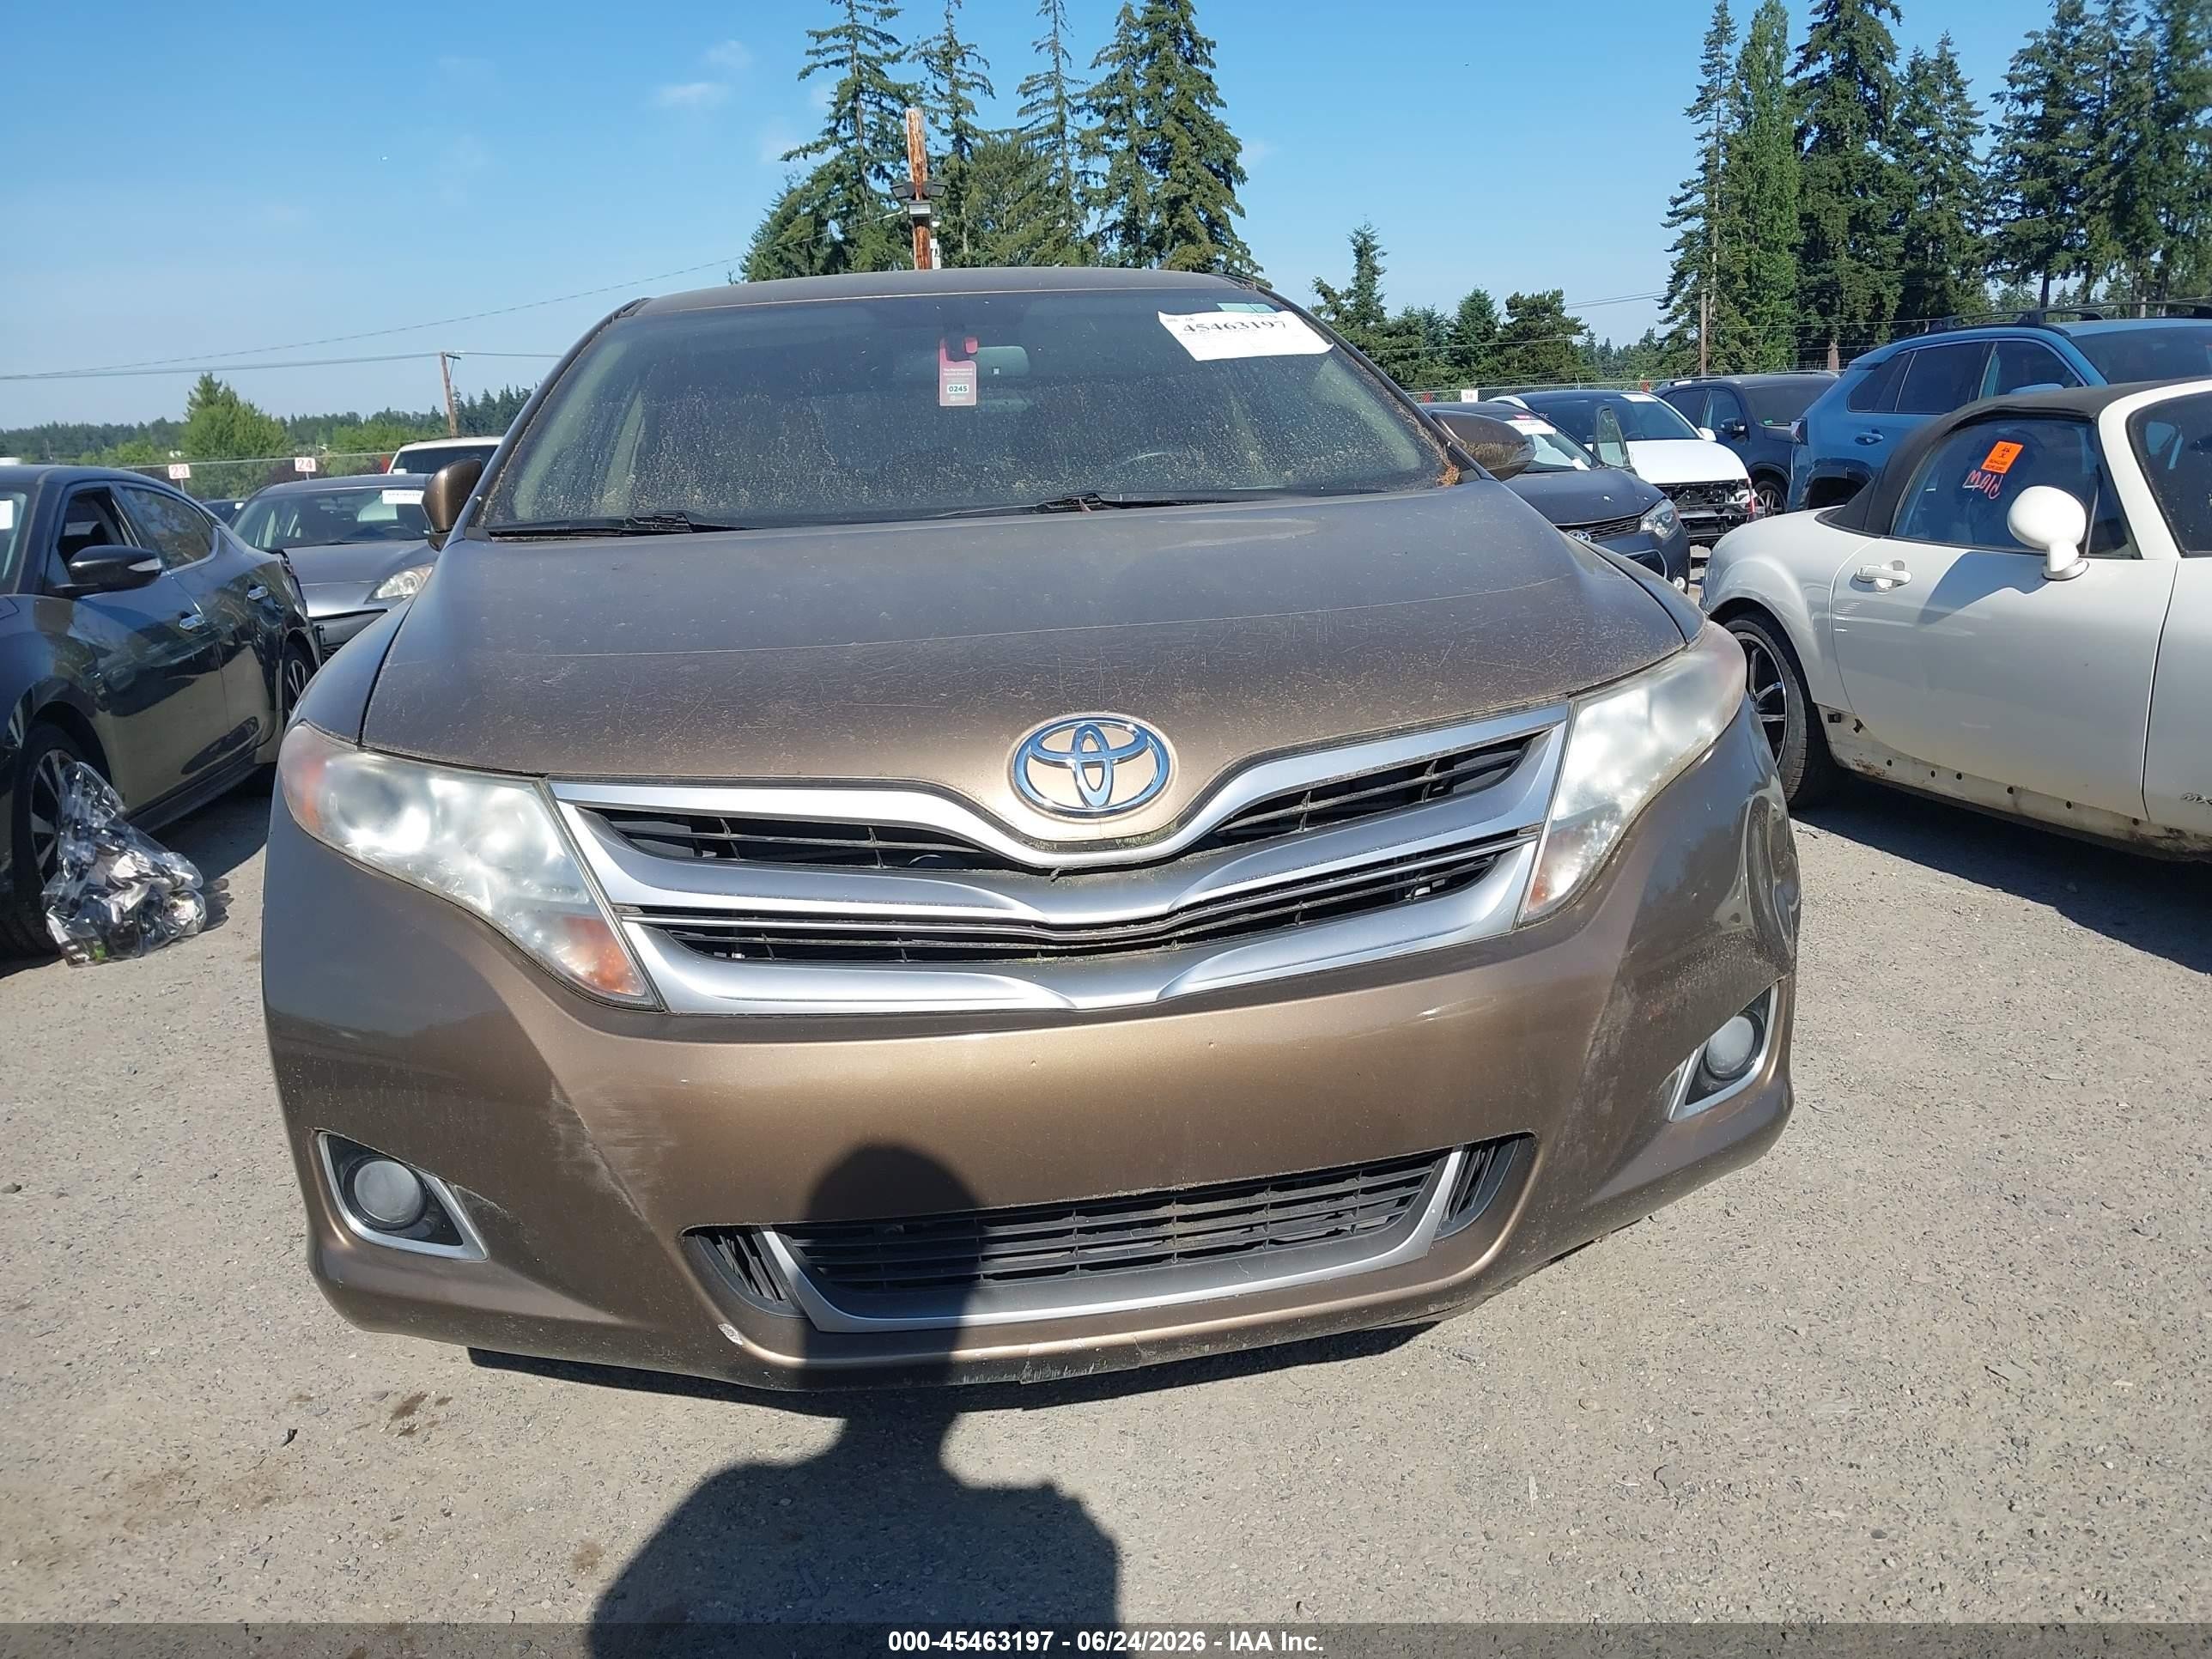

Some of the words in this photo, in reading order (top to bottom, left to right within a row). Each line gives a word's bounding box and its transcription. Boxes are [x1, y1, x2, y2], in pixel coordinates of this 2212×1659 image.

[1183, 320, 1286, 332] 45463197
[297, 459, 313, 470] 24
[171, 466, 187, 477] 23
